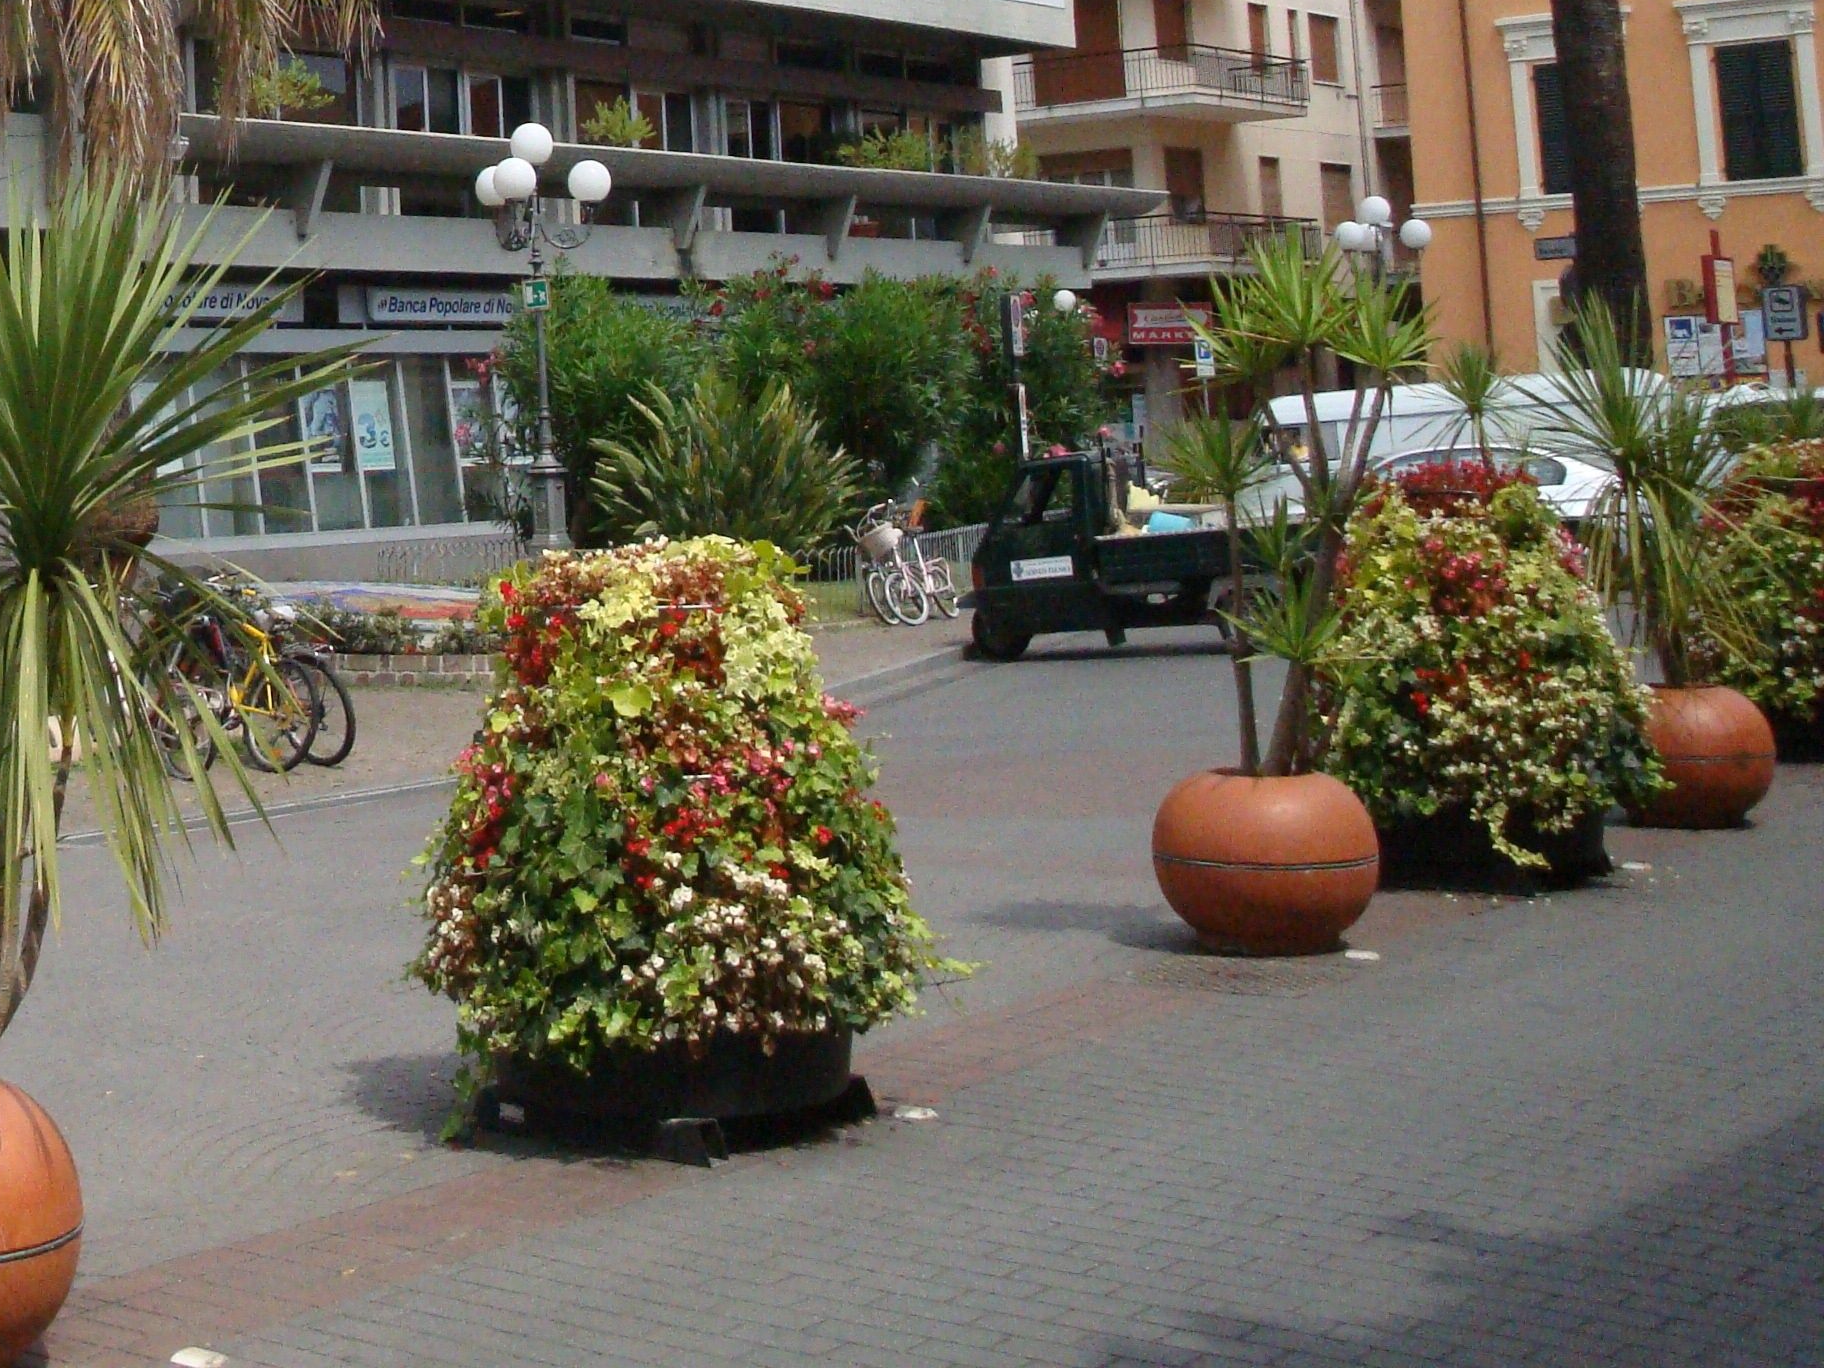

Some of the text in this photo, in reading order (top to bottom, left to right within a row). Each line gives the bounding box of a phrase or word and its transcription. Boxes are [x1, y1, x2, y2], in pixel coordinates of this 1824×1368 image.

[220, 292, 234, 309] di
[388, 296, 426, 314] Banca
[428, 297, 481, 317] Popolare
[483, 298, 495, 314] di
